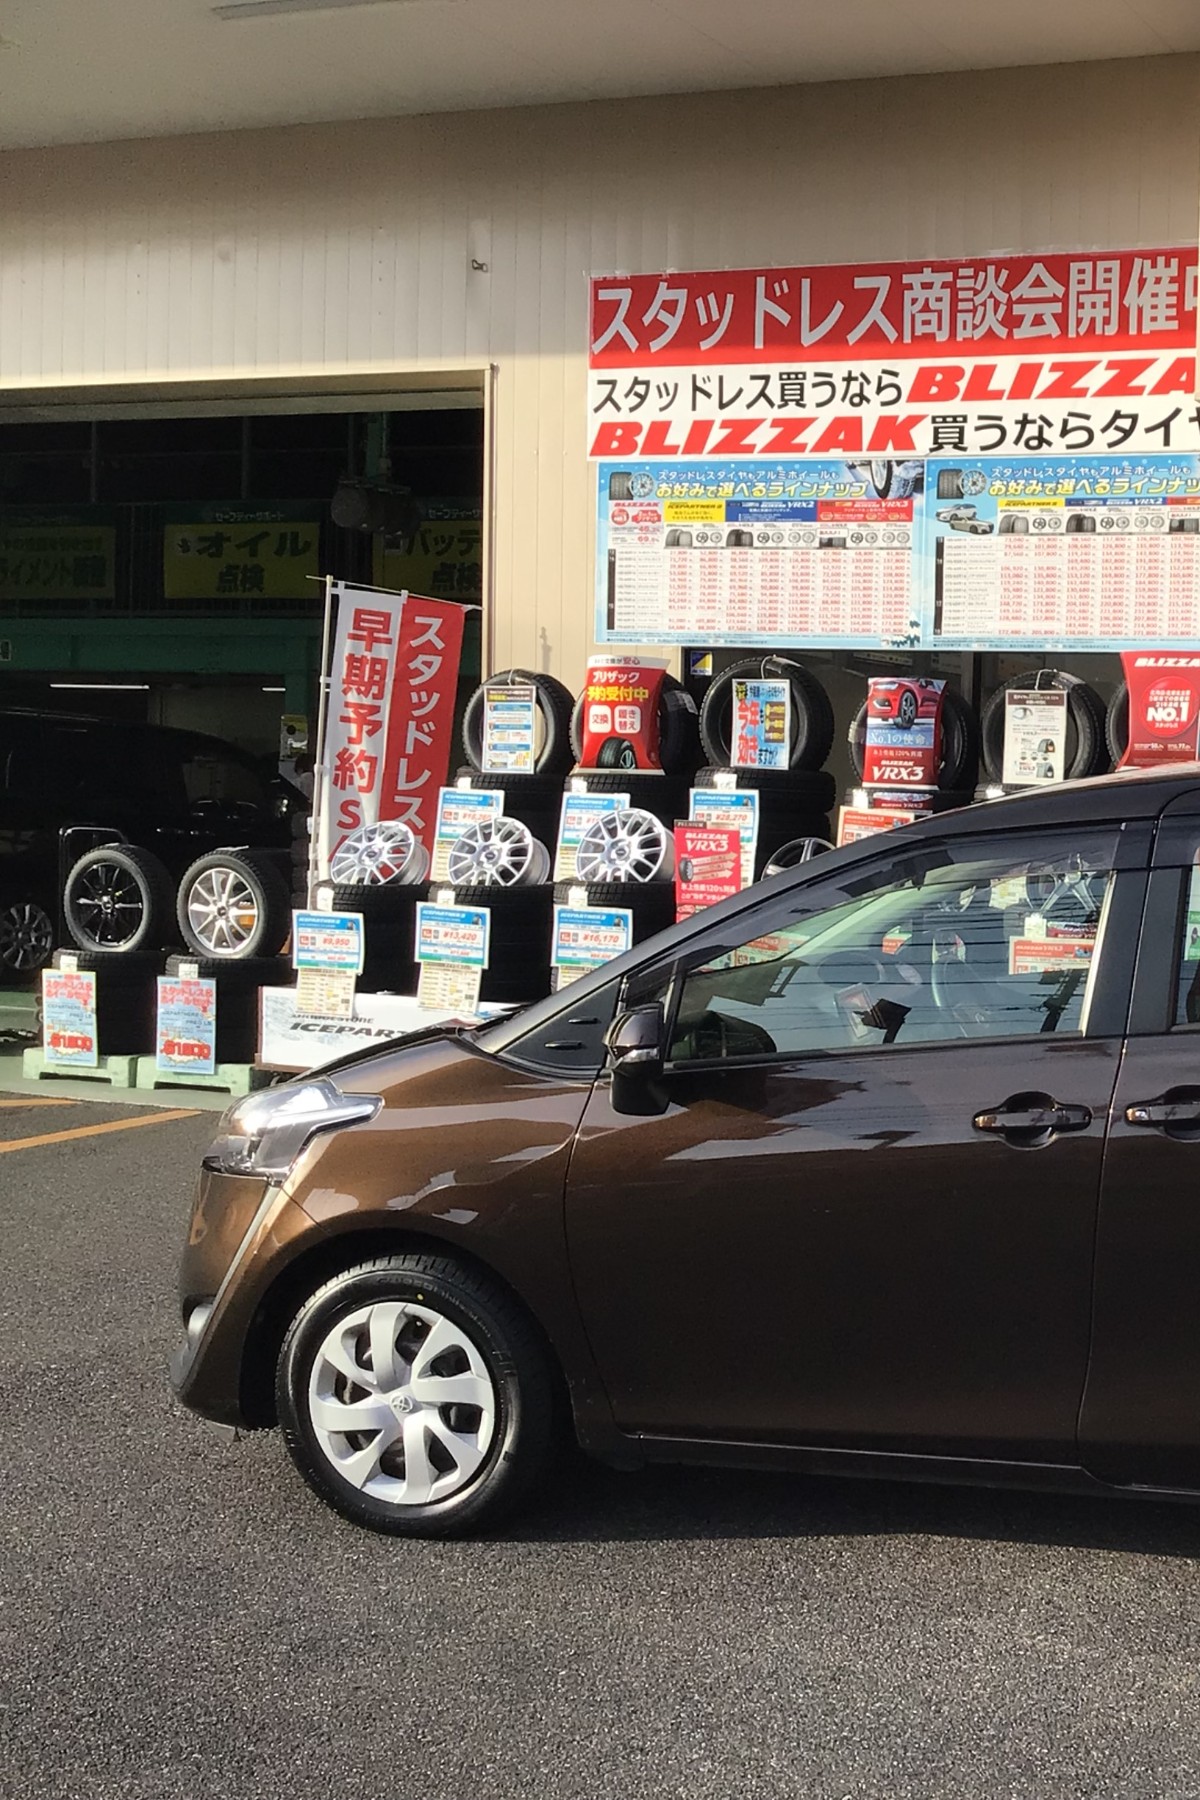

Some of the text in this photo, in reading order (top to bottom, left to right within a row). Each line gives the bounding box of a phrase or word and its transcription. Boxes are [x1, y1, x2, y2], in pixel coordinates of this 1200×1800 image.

[593, 367, 904, 414] スタッドレス買うなら
[589, 413, 935, 458] BLIZZAK
[658, 470, 839, 482] スタッドレスタイヤもアルミホイールも
[990, 466, 1192, 479] スタッドレスタイヤもアルミホイールも
[654, 479, 869, 499] お好みで選べるラインナップ
[196, 530, 312, 558] オイル
[405, 528, 481, 557] バッテ
[216, 563, 266, 593] 点検
[592, 670, 641, 684] ブリザック
[586, 685, 650, 702] 予約受付中
[591, 713, 610, 725] 交換
[1146, 701, 1190, 722] NO.1
[328, 608, 392, 862] 早期予約S
[392, 615, 446, 844] スタッドレス
[869, 733, 930, 746] No.1の使命。
[871, 766, 925, 781] VRX3
[684, 832, 730, 840] BLIZZAK
[685, 839, 730, 852] VRX3
[443, 930, 478, 942] ¥13,420
[582, 932, 620, 945] ¥16,170
